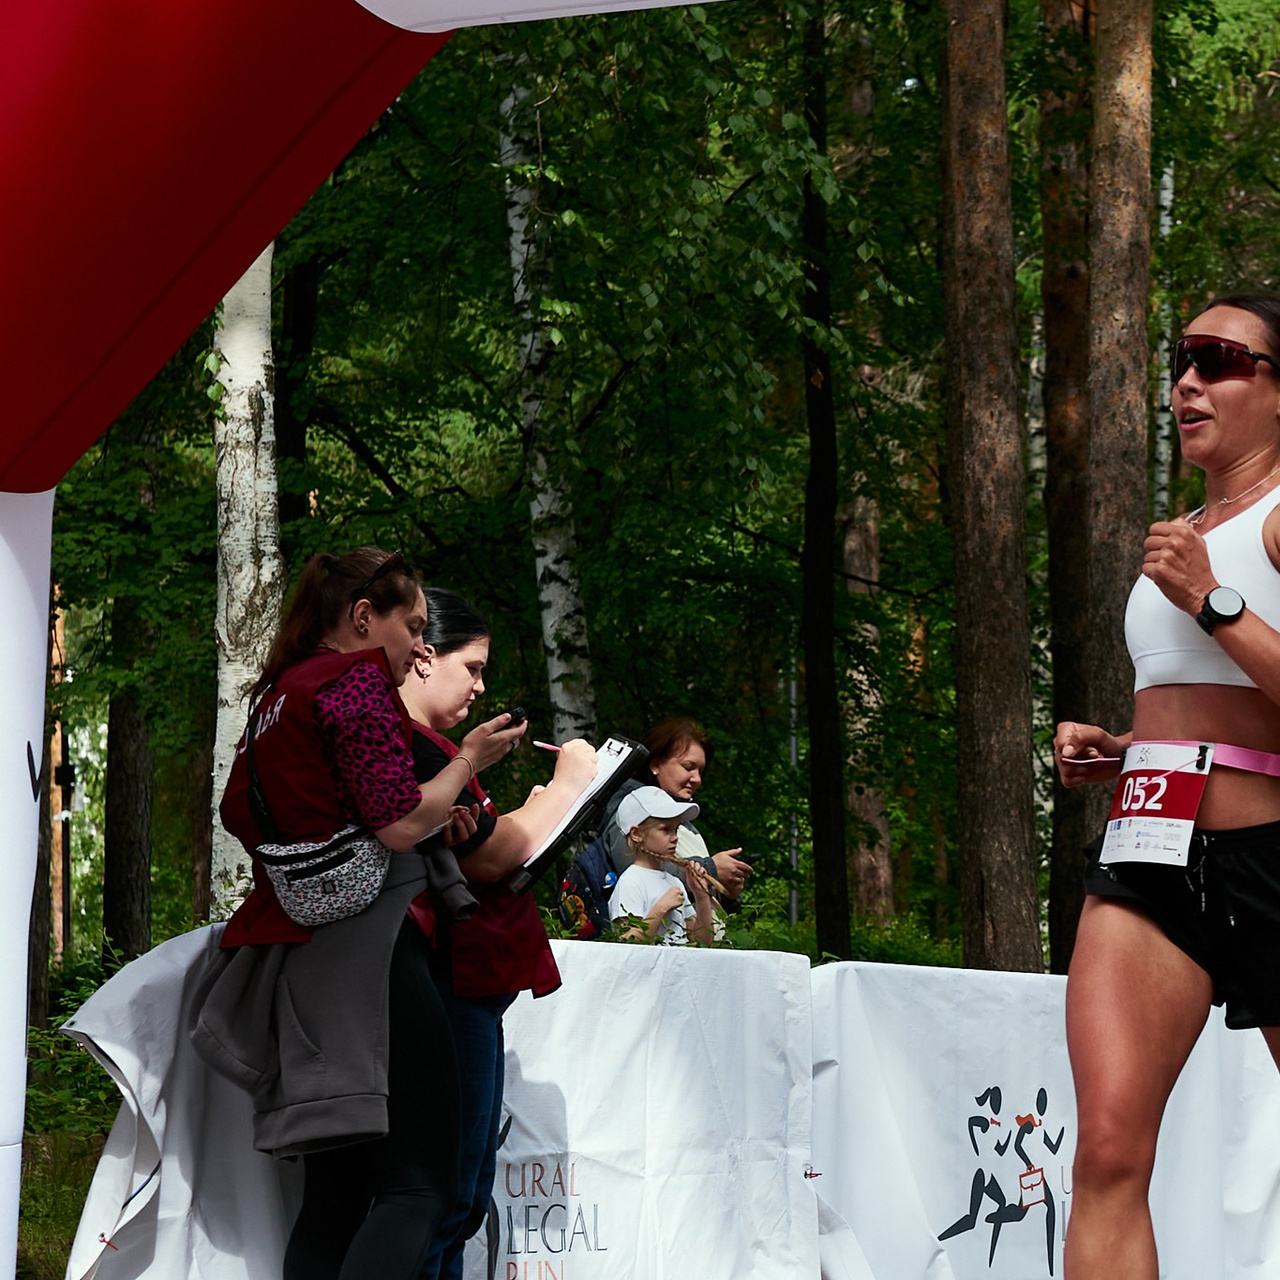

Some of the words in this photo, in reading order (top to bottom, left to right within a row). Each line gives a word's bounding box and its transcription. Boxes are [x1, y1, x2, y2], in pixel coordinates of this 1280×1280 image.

[1121, 776, 1168, 812] 052
[505, 1162, 581, 1198] URAL
[506, 1203, 608, 1255] LEGAL
